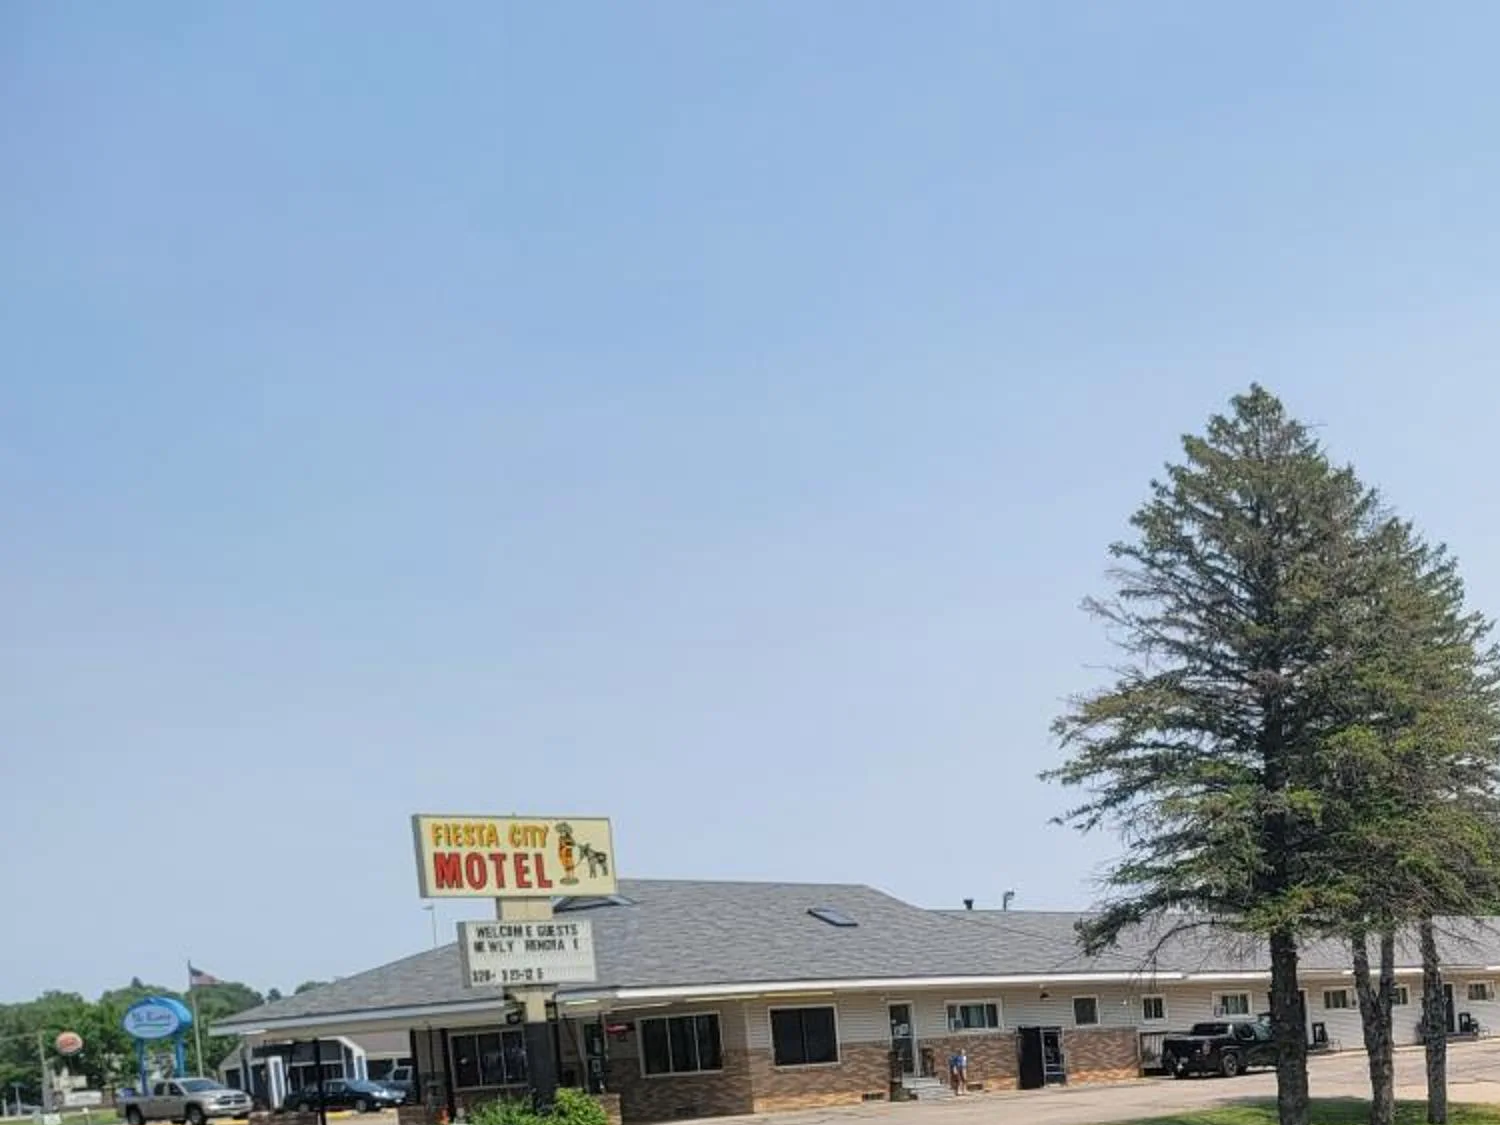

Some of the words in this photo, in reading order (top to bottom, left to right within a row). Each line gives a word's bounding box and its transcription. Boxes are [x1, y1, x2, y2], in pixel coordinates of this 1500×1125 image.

[431, 823, 499, 848] FIESTA
[508, 823, 549, 848] CITY
[433, 851, 553, 889] MOTEL
[476, 924, 532, 938] WELCOME
[536, 923, 578, 937] GUESTS
